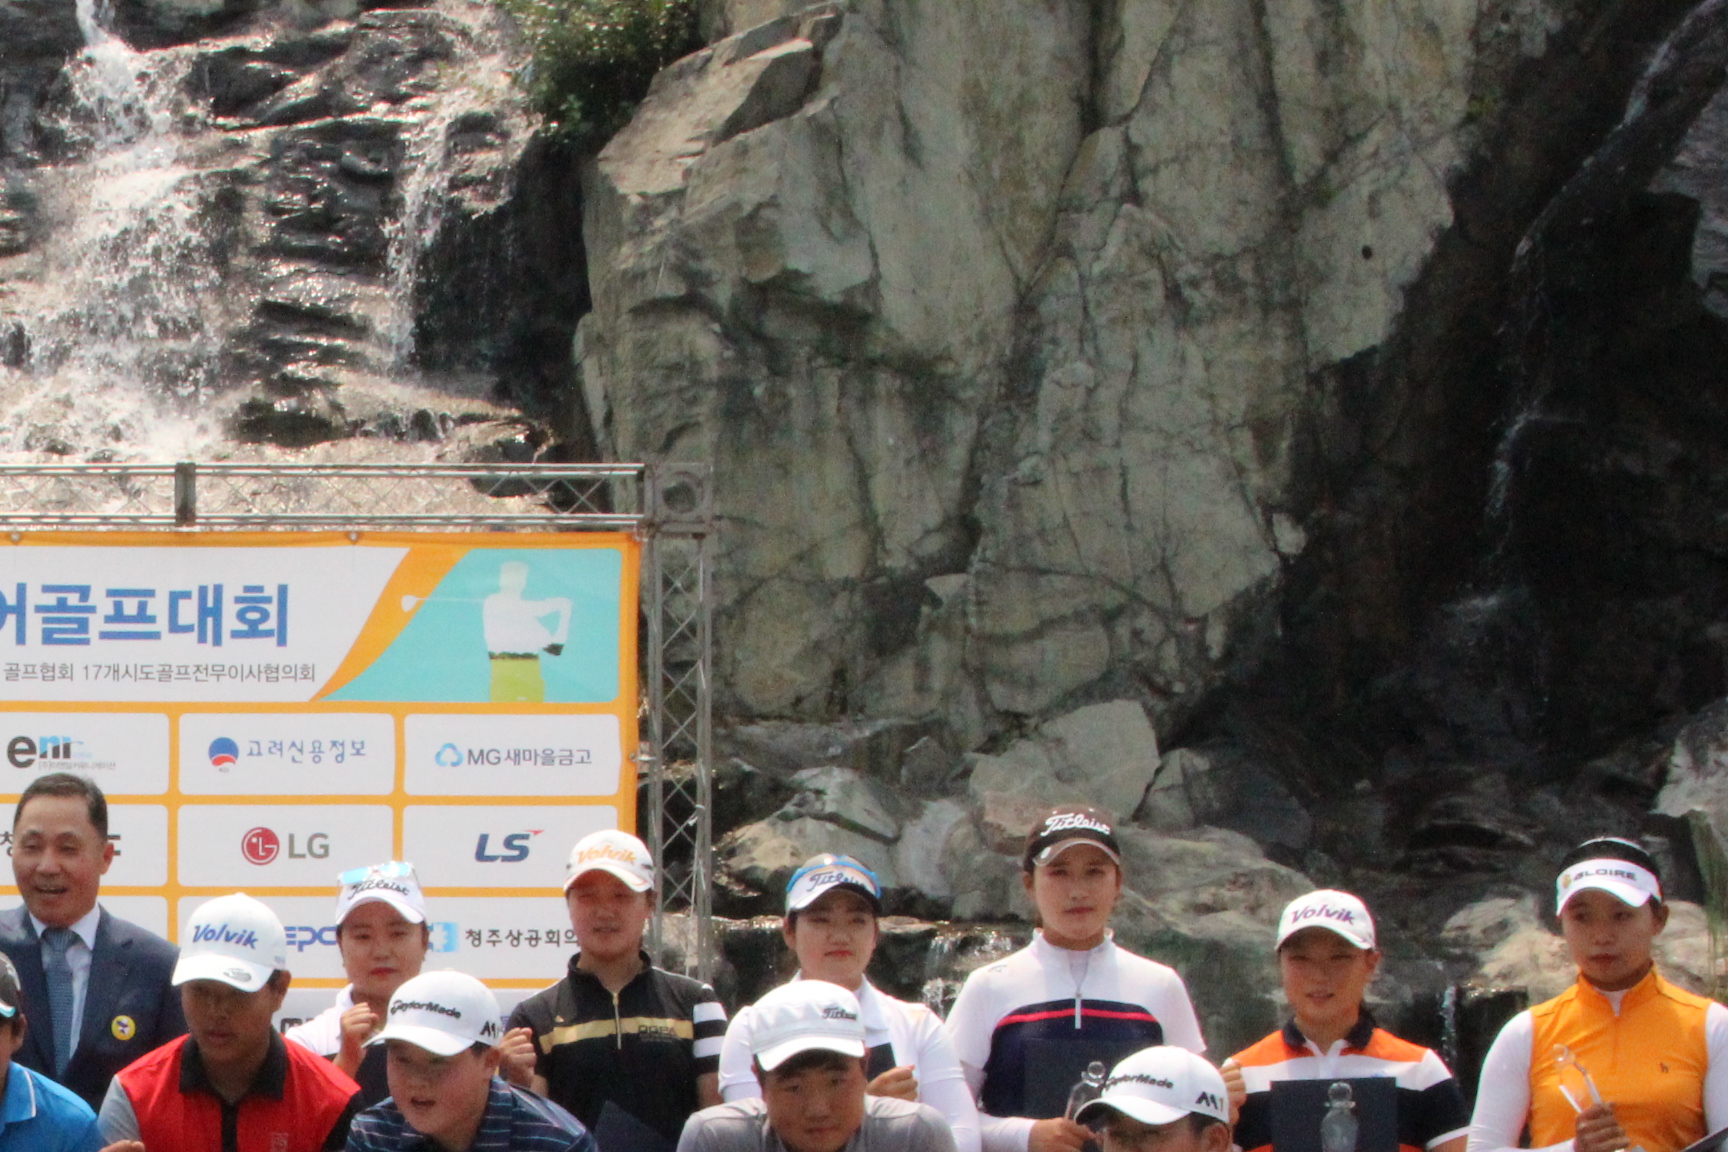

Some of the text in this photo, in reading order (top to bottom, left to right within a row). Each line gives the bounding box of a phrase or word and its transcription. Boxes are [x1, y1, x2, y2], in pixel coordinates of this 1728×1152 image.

[3, 663, 74, 683] 골프협회
[246, 738, 367, 764] 고려신용정보
[1038, 812, 1111, 838] Titleist
[288, 833, 330, 859] LG
[474, 833, 531, 863] LS
[577, 843, 638, 866] Volvik
[1291, 902, 1356, 927] Volvik
[193, 924, 259, 951] Volvik
[465, 929, 579, 947] 청주상공회의
[391, 1000, 462, 1019] TaylorMade
